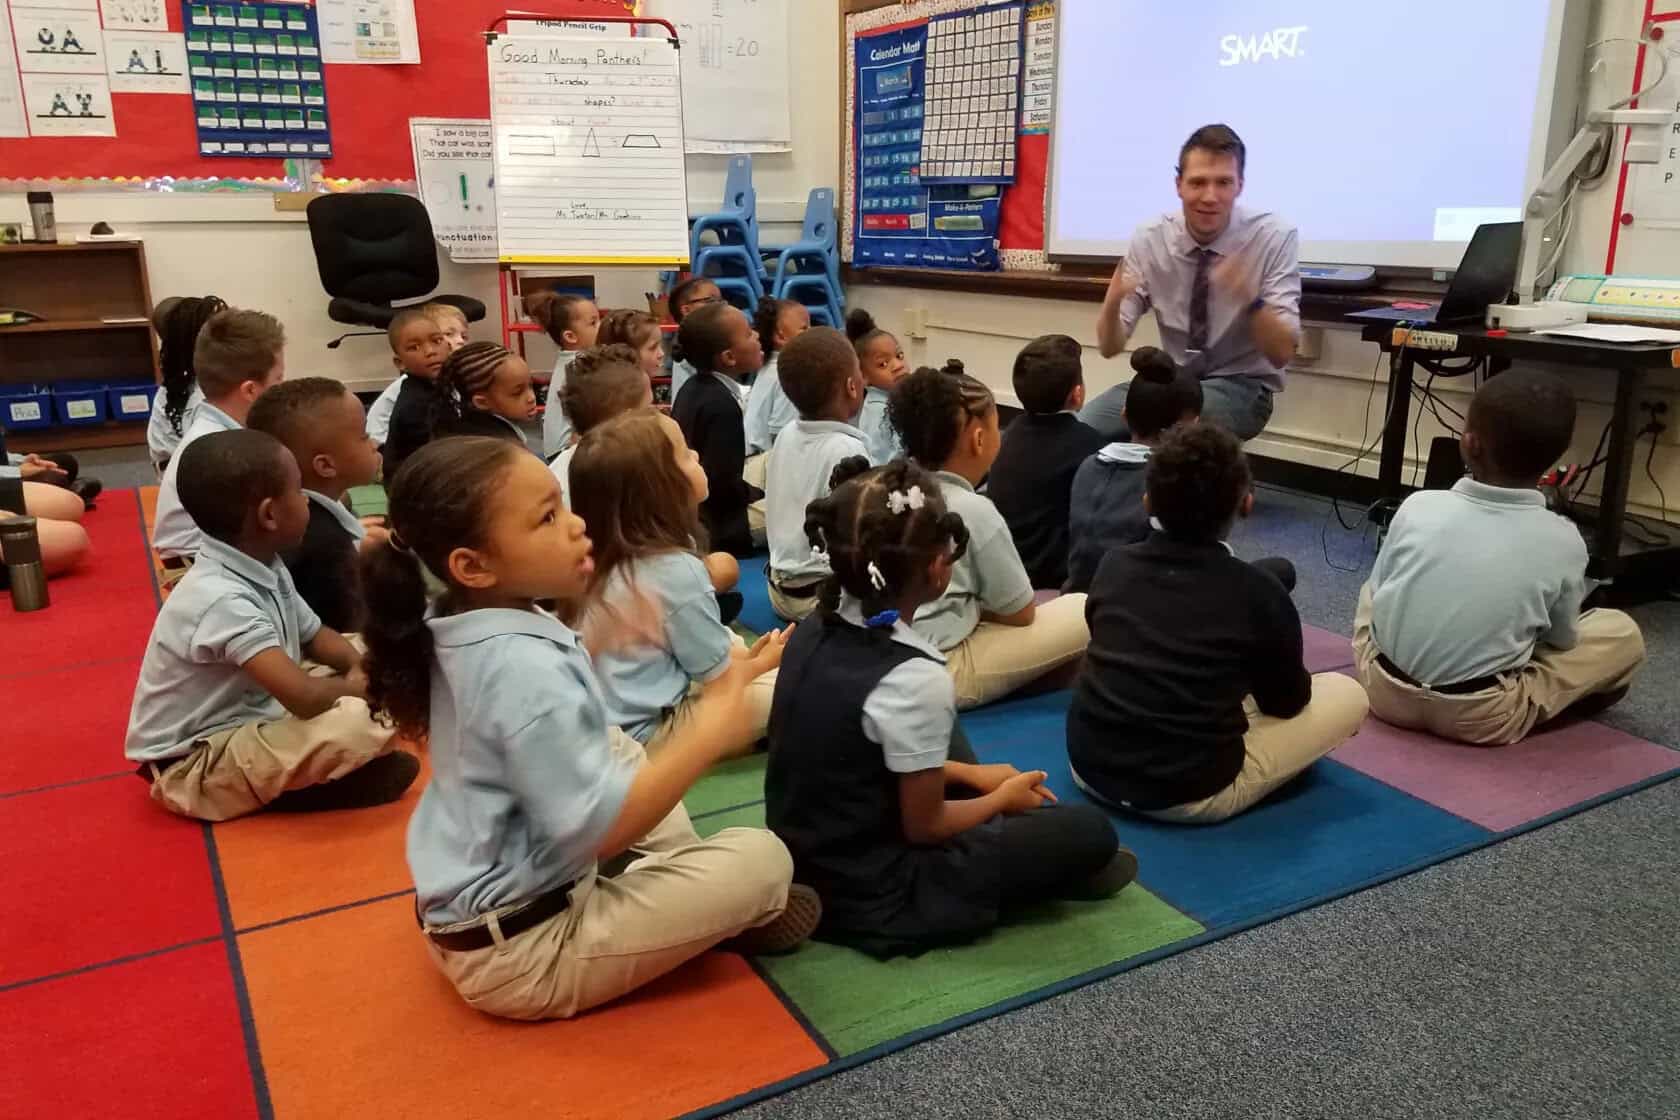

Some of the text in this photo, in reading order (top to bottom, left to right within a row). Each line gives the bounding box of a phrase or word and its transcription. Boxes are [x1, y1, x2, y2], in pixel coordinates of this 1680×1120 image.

[500, 44, 538, 64] Good
[549, 49, 589, 68] Morning
[870, 46, 901, 60] Calendar
[1669, 148, 1676, 159] E
[1664, 172, 1673, 183] P
